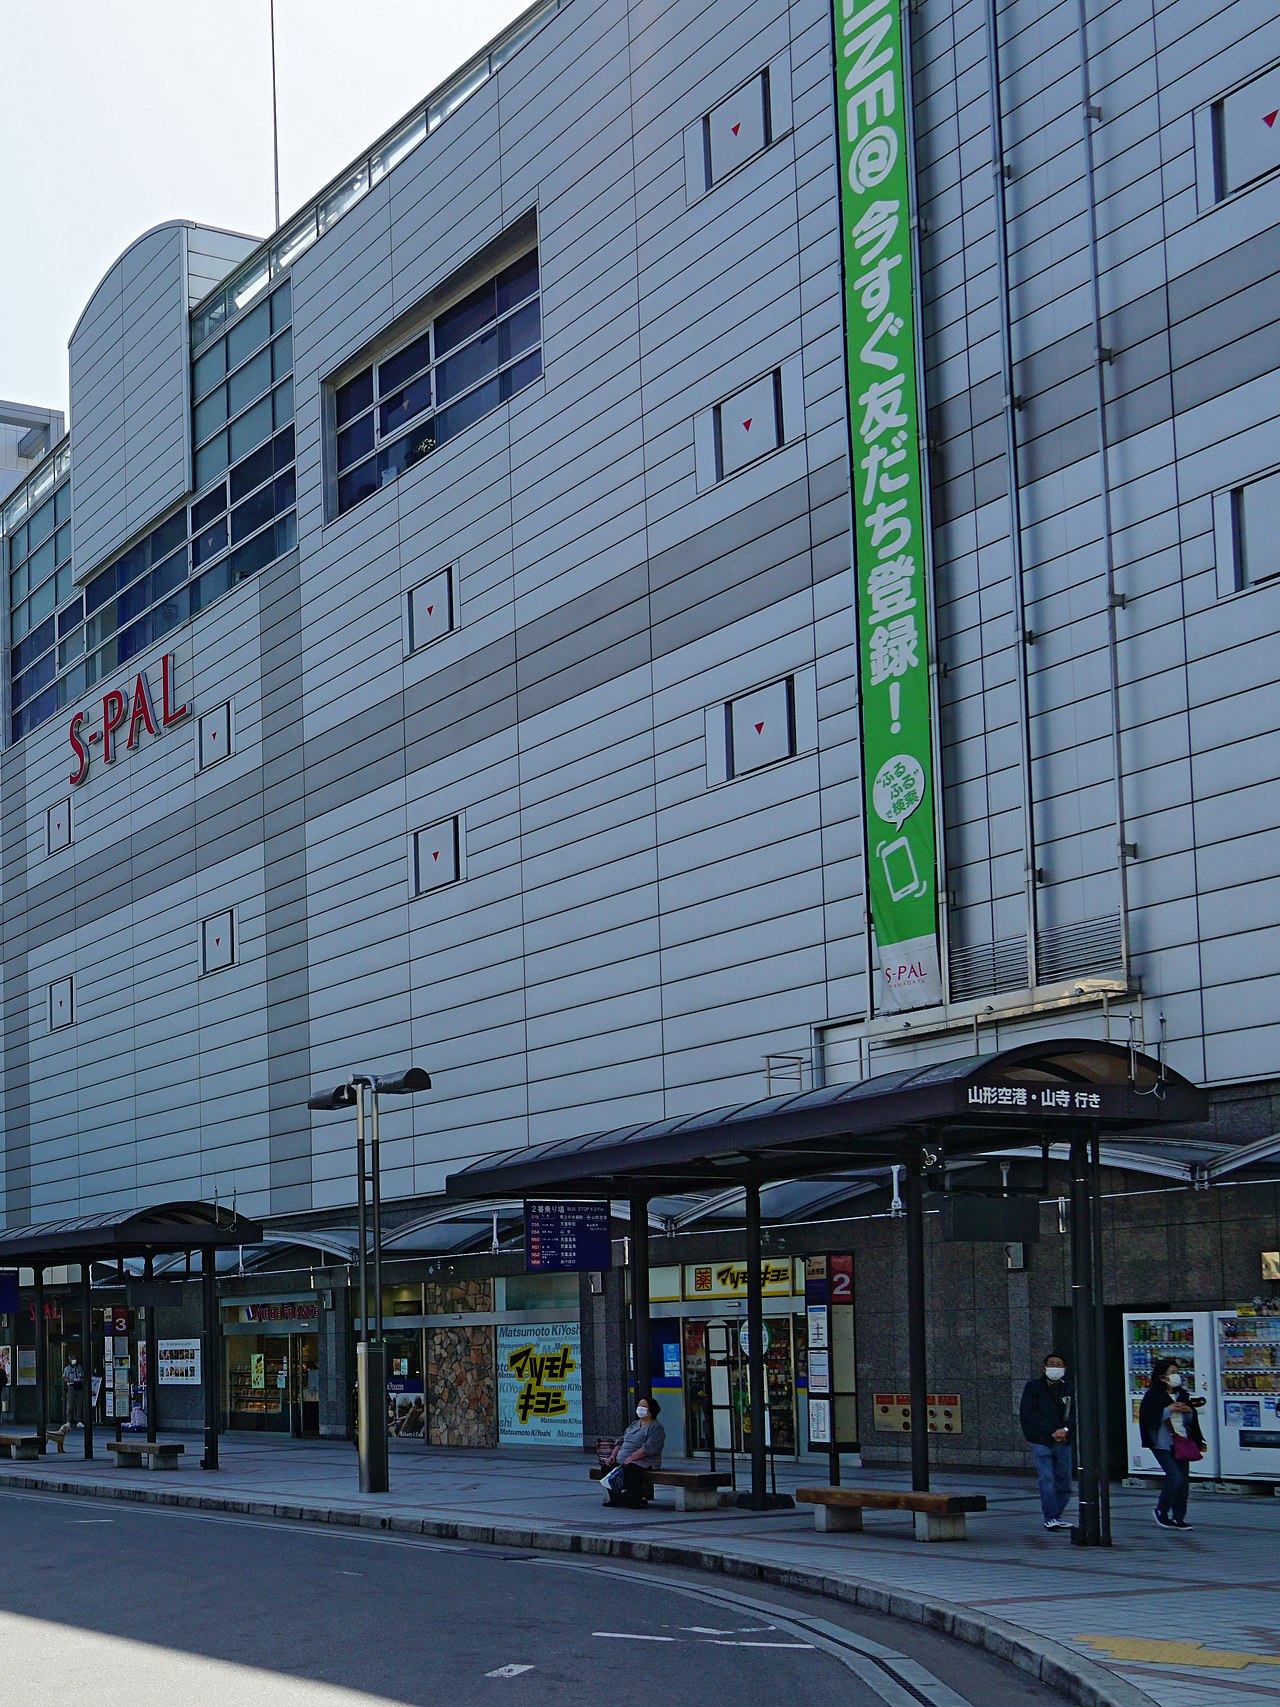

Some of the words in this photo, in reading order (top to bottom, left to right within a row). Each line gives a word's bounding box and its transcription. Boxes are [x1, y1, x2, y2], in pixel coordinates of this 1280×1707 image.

[69, 652, 193, 786] S-PAL
[885, 961, 928, 984] S-PAL
[967, 1085, 1071, 1107] 山形空港・山寺
[1074, 1092, 1101, 1109] 行き
[696, 1269, 711, 1289] 薬
[716, 1265, 790, 1289] マツモキヨシ
[832, 1273, 852, 1295] 2
[115, 1318, 127, 1331] 3
[499, 1326, 551, 1338] Matsumoto
[510, 1347, 574, 1387] マツモト
[518, 1383, 567, 1421] キヨシ
[499, 1428, 530, 1436] Matsumoto
[530, 1429, 552, 1437] KiYoshi
